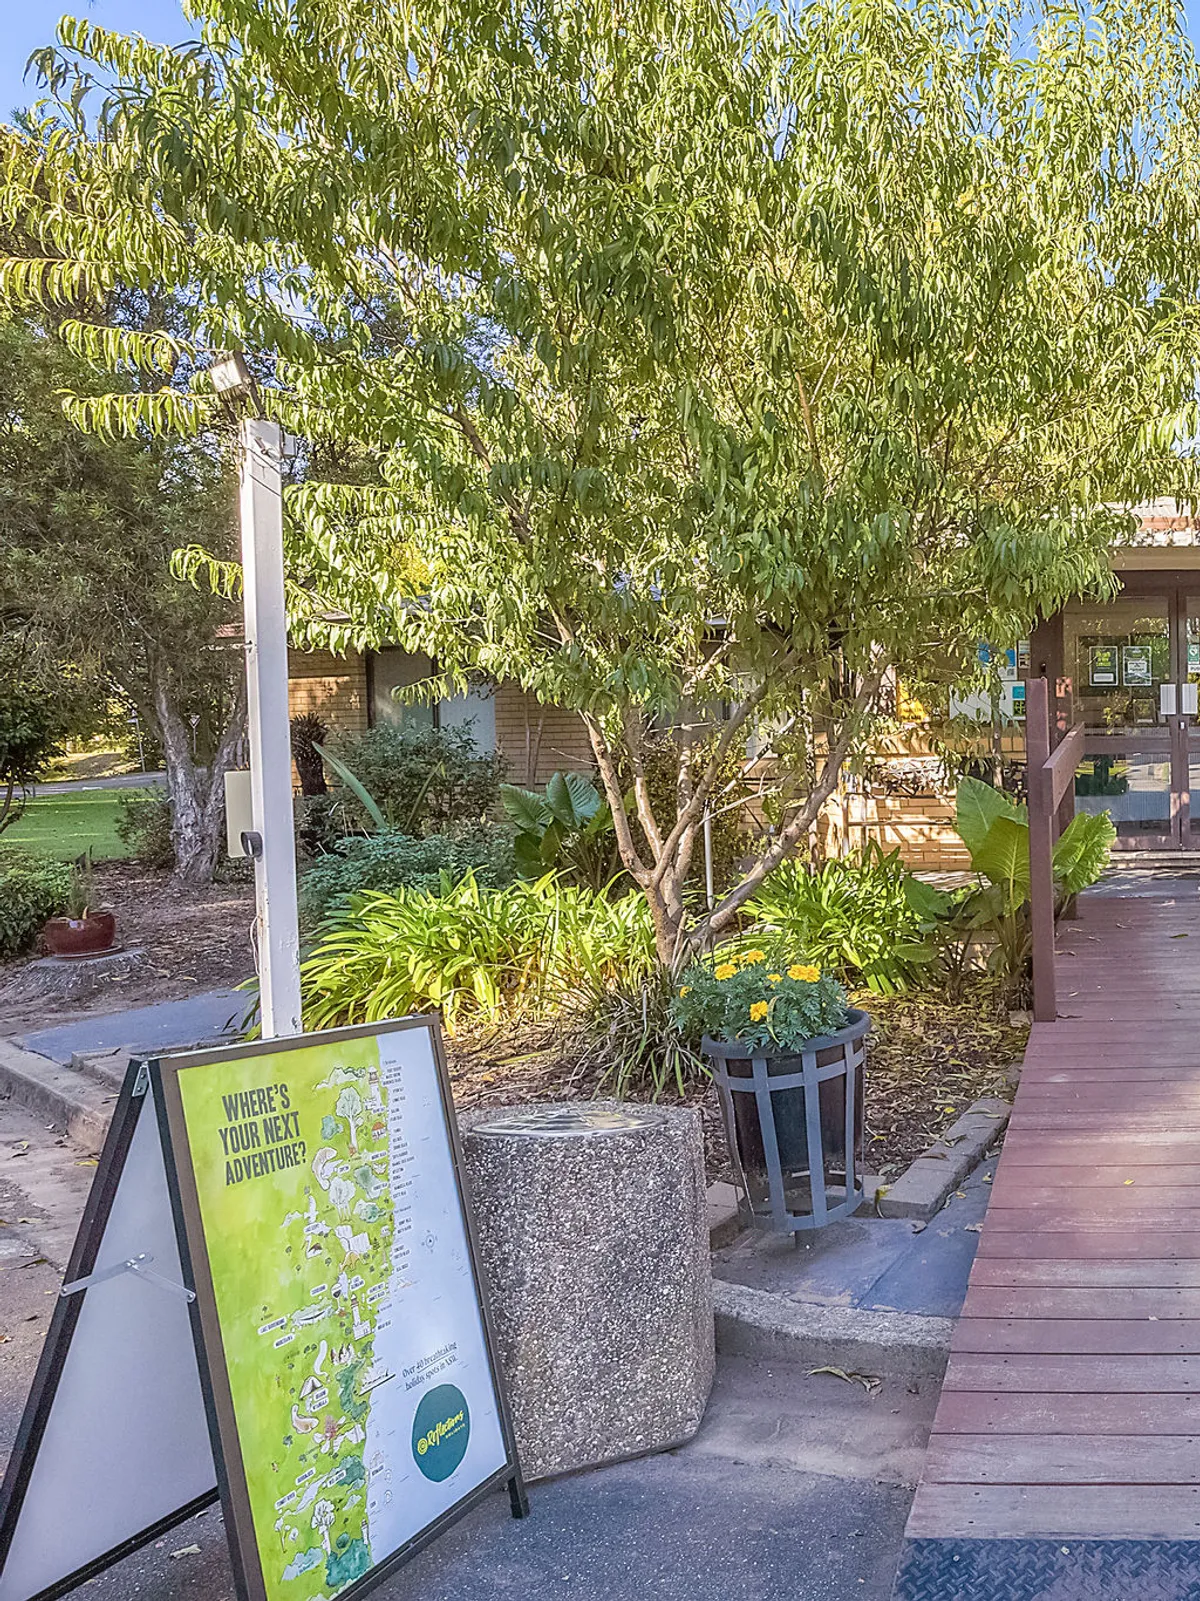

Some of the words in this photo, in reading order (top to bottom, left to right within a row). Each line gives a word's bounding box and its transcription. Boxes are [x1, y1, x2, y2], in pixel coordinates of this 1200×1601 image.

[222, 1083, 291, 1122] WHERE'S
[218, 1123, 261, 1156] YOUR
[263, 1111, 301, 1145] NEXT
[225, 1140, 307, 1186] ADVENTURE?
[402, 1367, 417, 1378] Over
